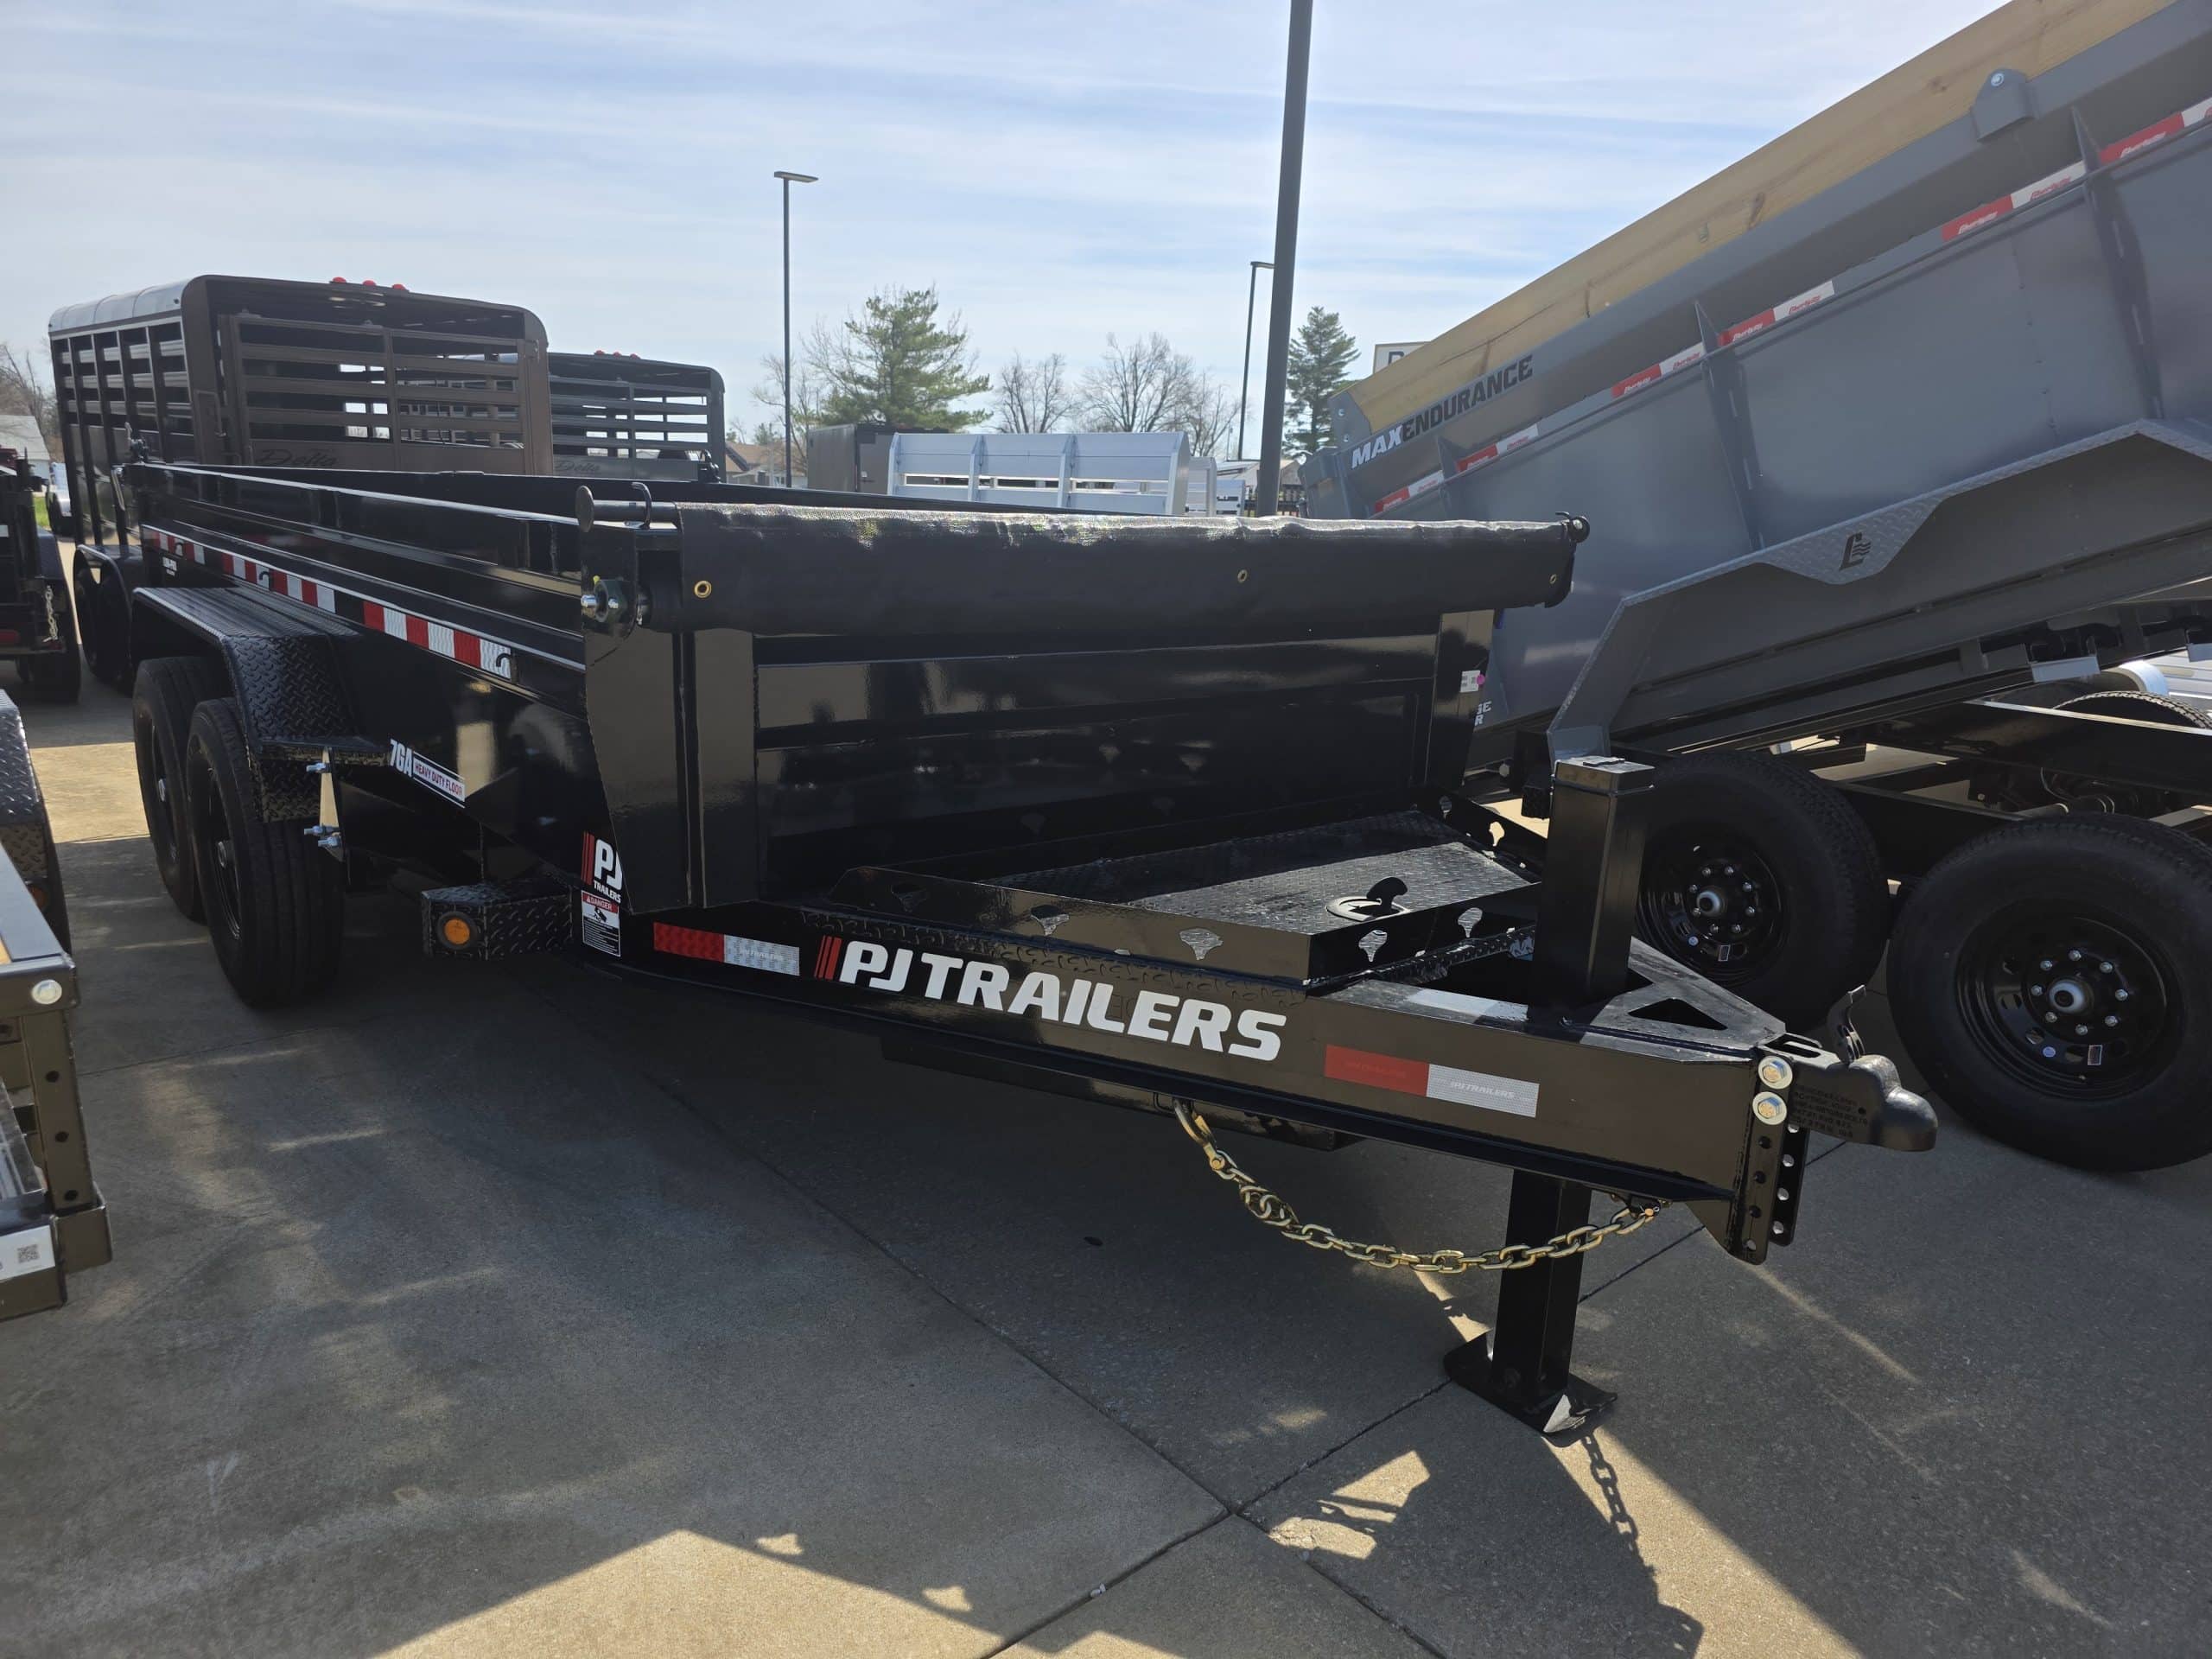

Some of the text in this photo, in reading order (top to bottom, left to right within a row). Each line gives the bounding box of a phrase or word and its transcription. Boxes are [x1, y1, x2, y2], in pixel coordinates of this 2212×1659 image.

[390, 739, 412, 778] 7GA
[415, 763, 433, 779] HEAVY
[432, 772, 446, 787] DUTY
[594, 880, 621, 904] TRAILERS
[590, 898, 612, 912] DANGER
